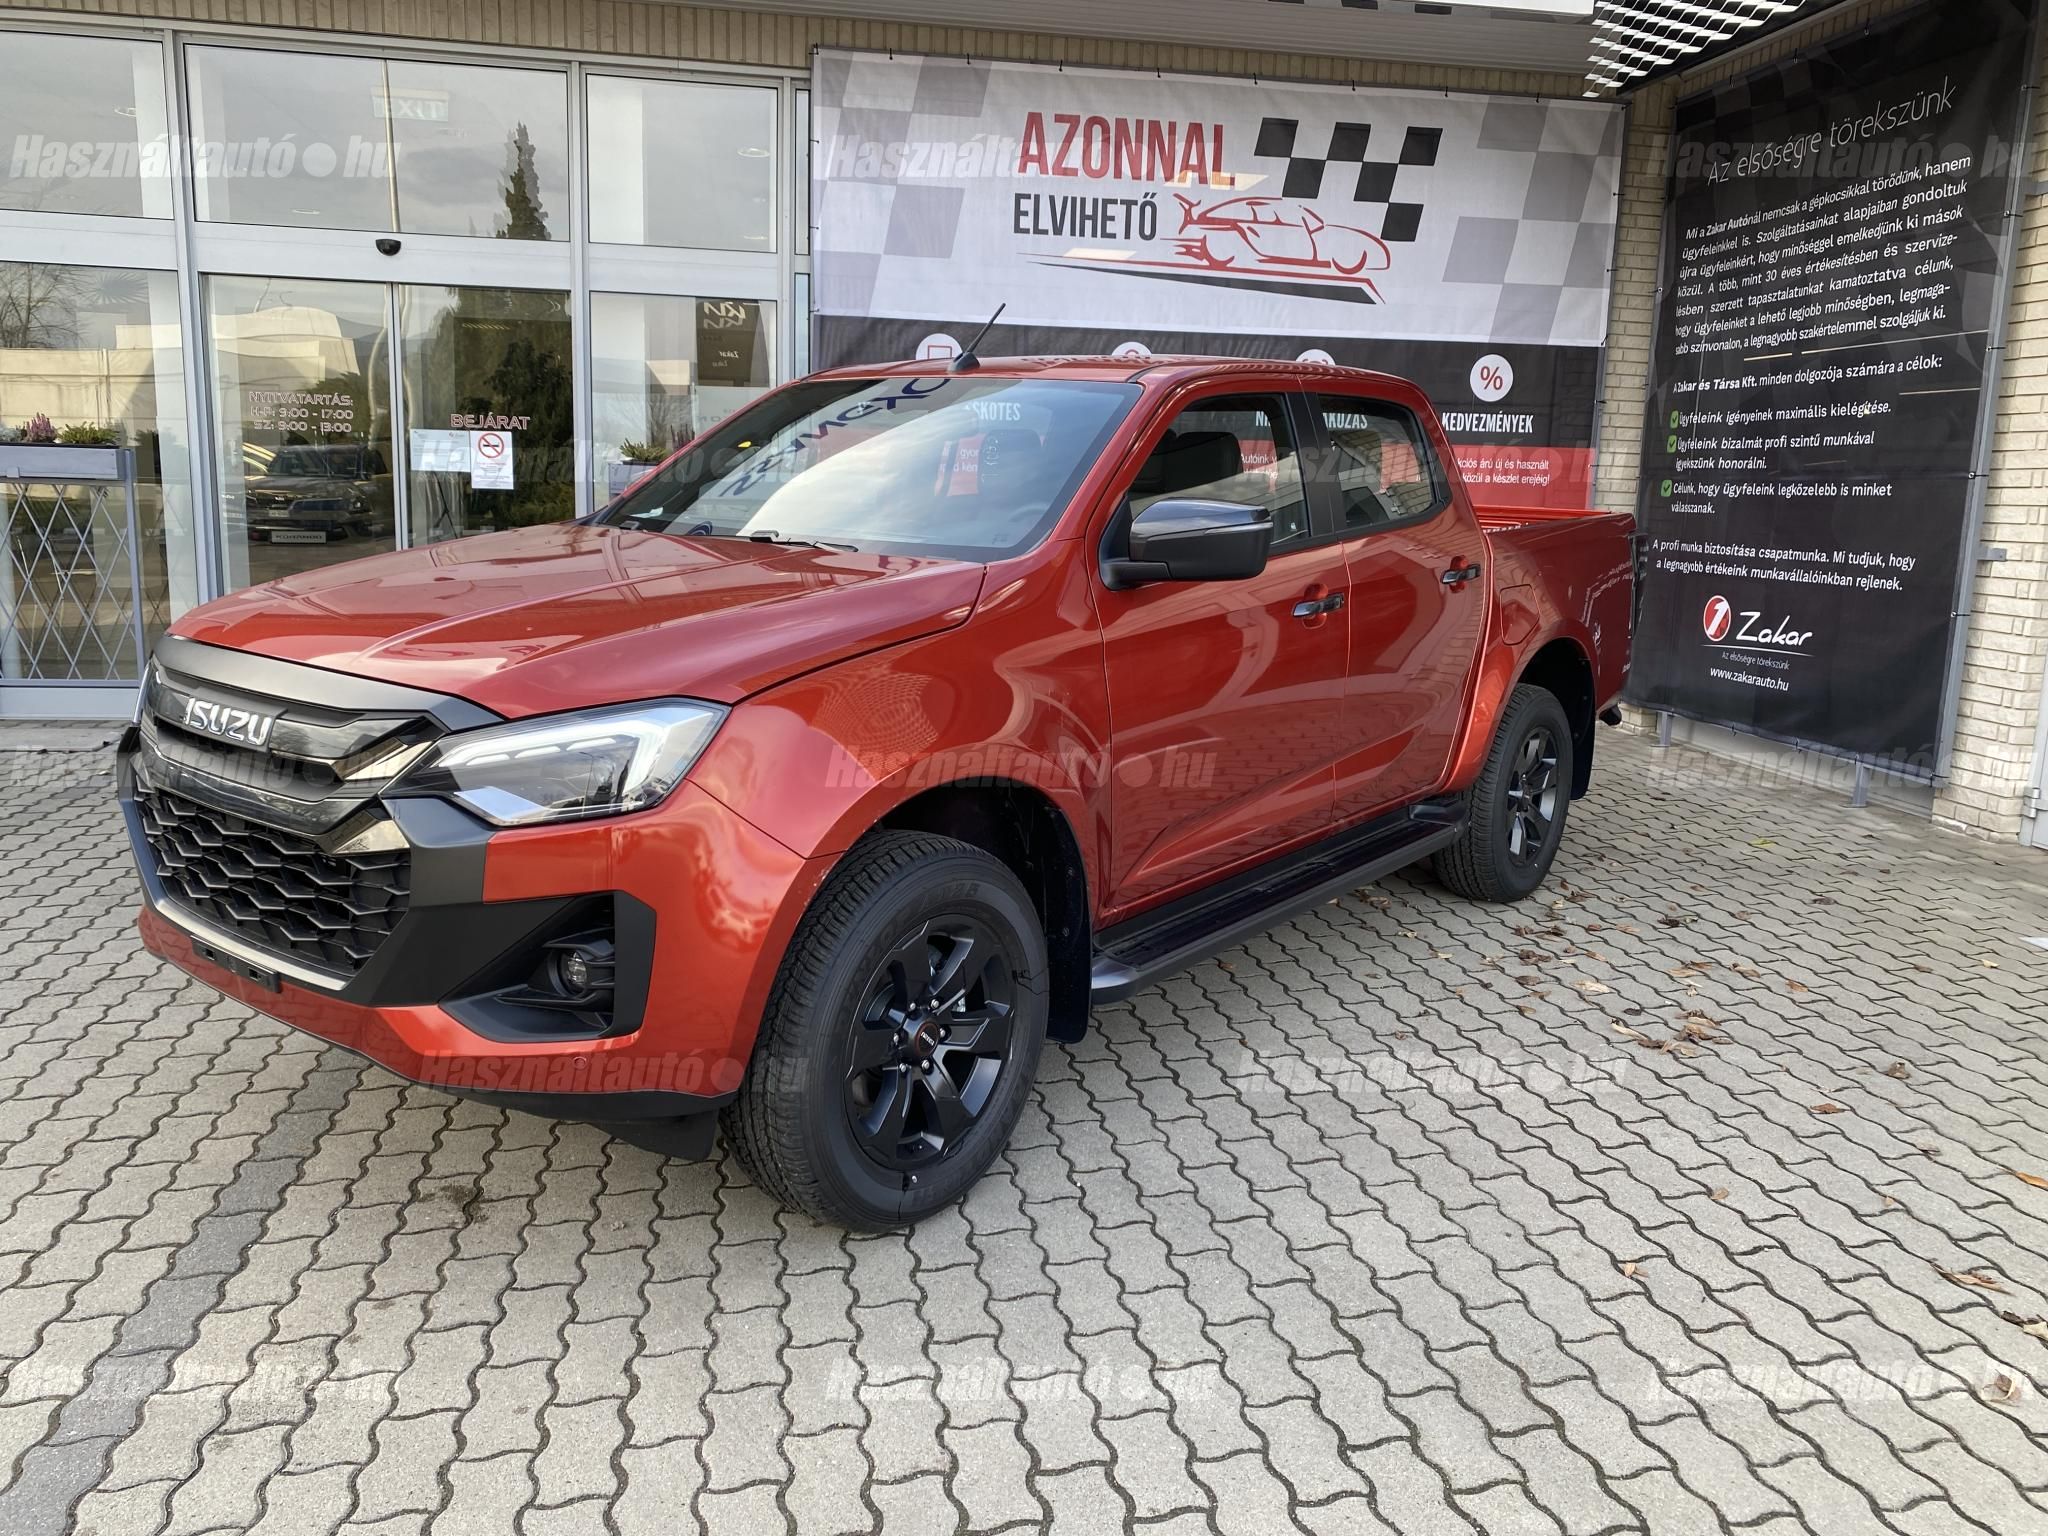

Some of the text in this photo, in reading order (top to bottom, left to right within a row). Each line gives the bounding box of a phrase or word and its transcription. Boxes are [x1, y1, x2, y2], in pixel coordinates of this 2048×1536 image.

[1708, 75, 1956, 186] Az elsőségre törekszünk
[1018, 112, 1236, 186] AZONNAL
[1686, 156, 1971, 240] Mi a Zakar Autónál nemcsak a gépkocsikkal törődünk, hanem
[1013, 192, 1158, 241] ELVIHETŐ
[1682, 179, 1968, 261] ügyfeleinkkel is. Szolgáltatásainkat alapjaiban gondoltuk
[1680, 204, 1963, 280] újra ügyfeleinkért, hogy minőséggel emelkedjünk ki mások
[1678, 234, 1958, 298] közül. A több, mint 30 éves értékesítésben és szervize-
[1710, 298, 1743, 312] szerzett
[1748, 282, 1824, 308] tapasztalatunkat
[1830, 267, 1906, 292] kamatoztatva
[1914, 256, 1954, 276] célunk,
[1694, 317, 1748, 336] ügyfeleinket
[1750, 318, 1755, 326] a
[1758, 308, 1786, 325] lehető
[1789, 299, 1822, 322] legjobb
[1825, 294, 1894, 313] minőségben,
[1900, 284, 1950, 304] legmaga-
[1690, 338, 1742, 354] színvonalon,
[1744, 338, 1748, 347] a
[1750, 328, 1798, 348] legnagyobb
[1800, 316, 1877, 340] szakértelemmel
[1880, 307, 1930, 328] szolgáljuk
[1933, 304, 1946, 320] ki.
[1678, 380, 1697, 392] Zakar
[1698, 378, 1710, 390] és
[1714, 378, 1740, 390] Társa
[1742, 375, 1758, 388] Kft.
[1759, 374, 1792, 386] minden
[1794, 366, 1843, 384] dolgozója
[1846, 363, 1894, 378] számára
[1897, 362, 1903, 372] a
[1906, 354, 1942, 370] célok:
[278, 421, 308, 430] 9:00
[320, 422, 352, 432] 13:00
[279, 408, 308, 418] 9:00
[321, 409, 354, 420] 17:00
[450, 412, 530, 430] BEJÁRAT
[1442, 410, 1533, 433] KEDVEZMÉNYEK
[1726, 408, 1772, 426] igényeinek
[1776, 402, 1827, 420] maximális
[1830, 400, 1892, 417] kielégítése.
[1721, 436, 1762, 450] bizalmát
[1764, 434, 1787, 450] profi
[1790, 432, 1820, 448] szintű
[1823, 430, 1875, 446] munkával
[1458, 458, 1478, 468] kciós
[1496, 458, 1502, 470] új
[1505, 459, 1514, 469] és
[1516, 459, 1549, 470] használt
[1492, 473, 1519, 484] készlet
[1522, 474, 1550, 486] erejéig!
[1675, 456, 1767, 472] igyekszünk honorálni.
[1673, 482, 1892, 498] Célunk, hogy ügyfeleink legközelebb is minket
[1671, 502, 1716, 514] válasszanak.
[1652, 539, 1916, 572] A profi munka biztosítása csapatmunka. Mi tudjuk, hogy
[1656, 559, 1903, 591] a legnagyobb értékeink munkavállalóinkban rejlenek.
[1736, 611, 1813, 646] Zakar
[1710, 666, 1790, 692] www.zakarauto.hu
[183, 698, 273, 745] ISUZU
